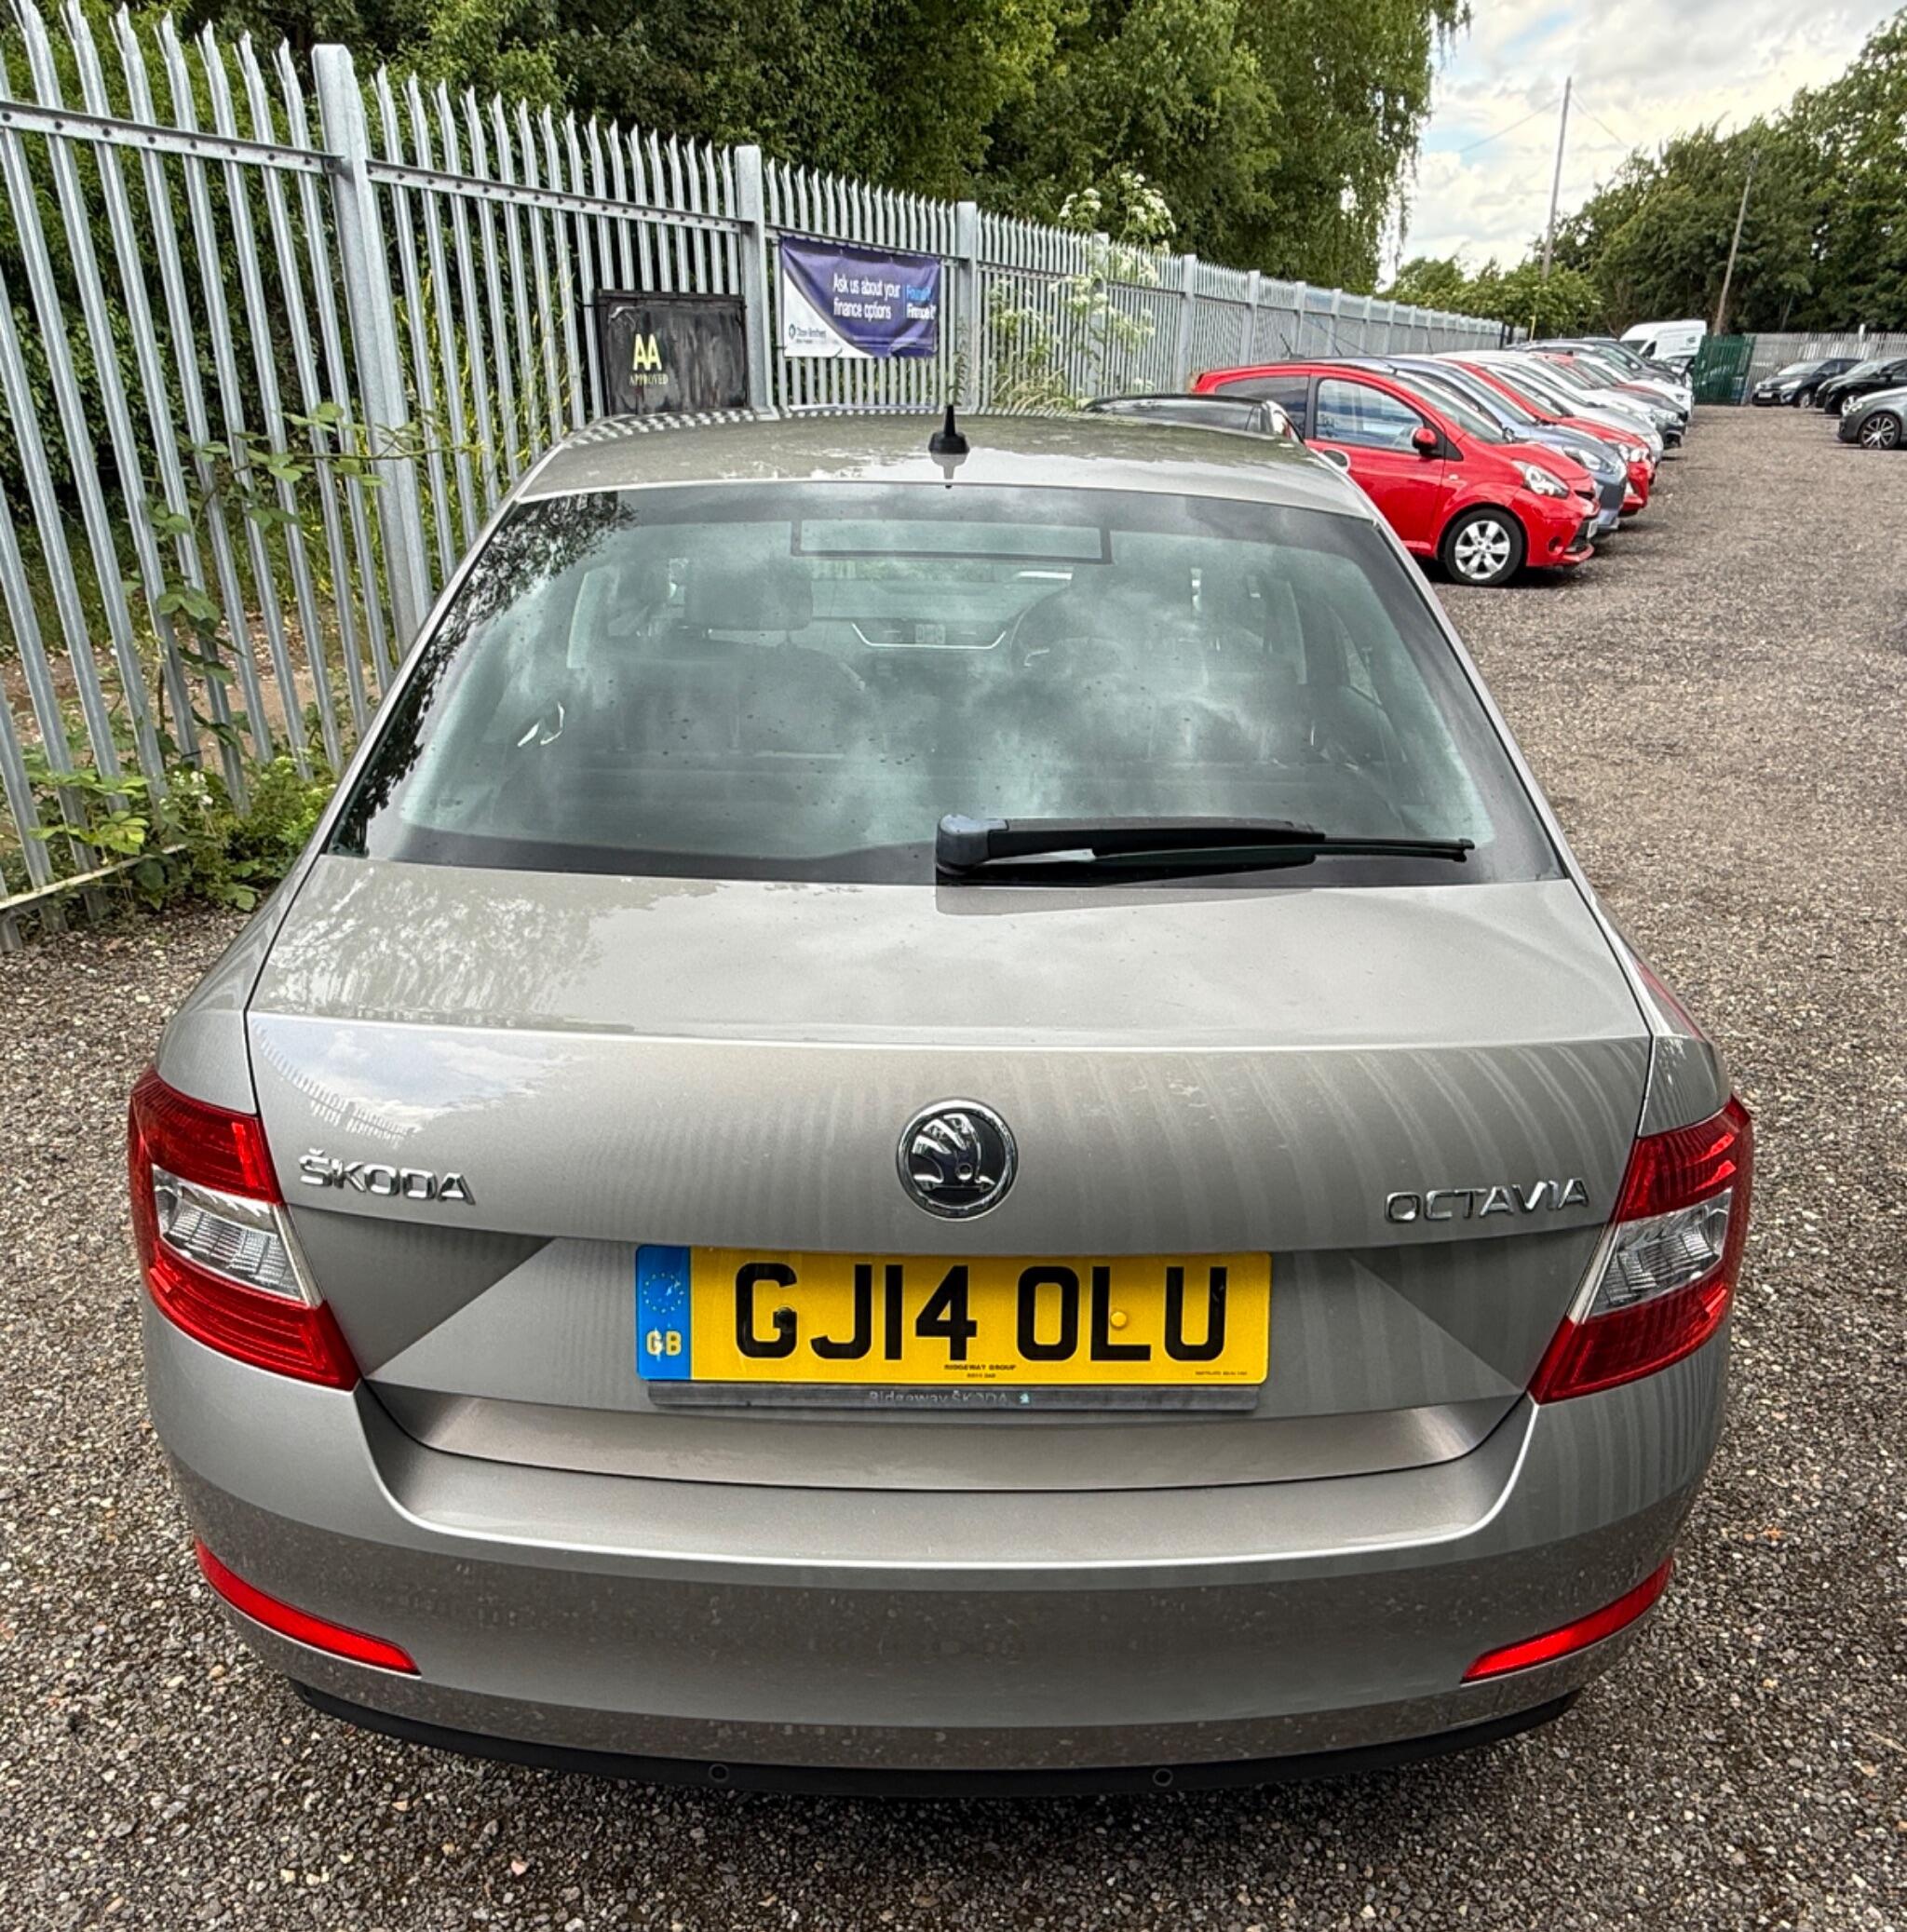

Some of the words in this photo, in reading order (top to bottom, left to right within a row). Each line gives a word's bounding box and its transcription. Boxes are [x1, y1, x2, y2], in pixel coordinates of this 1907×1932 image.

[832, 272, 848, 293] Ask
[850, 279, 859, 294] us
[861, 276, 883, 296] about
[884, 283, 901, 302] your
[833, 297, 862, 317] finance
[864, 301, 892, 322] options
[633, 333, 662, 371] AA
[629, 373, 669, 386] APPROVED
[299, 1147, 476, 1206] ŠKODA
[1384, 1177, 1590, 1223] OCTAVIA
[734, 1261, 978, 1361] GJ14
[1016, 1263, 1228, 1363] OLU
[646, 1330, 682, 1356] GB
